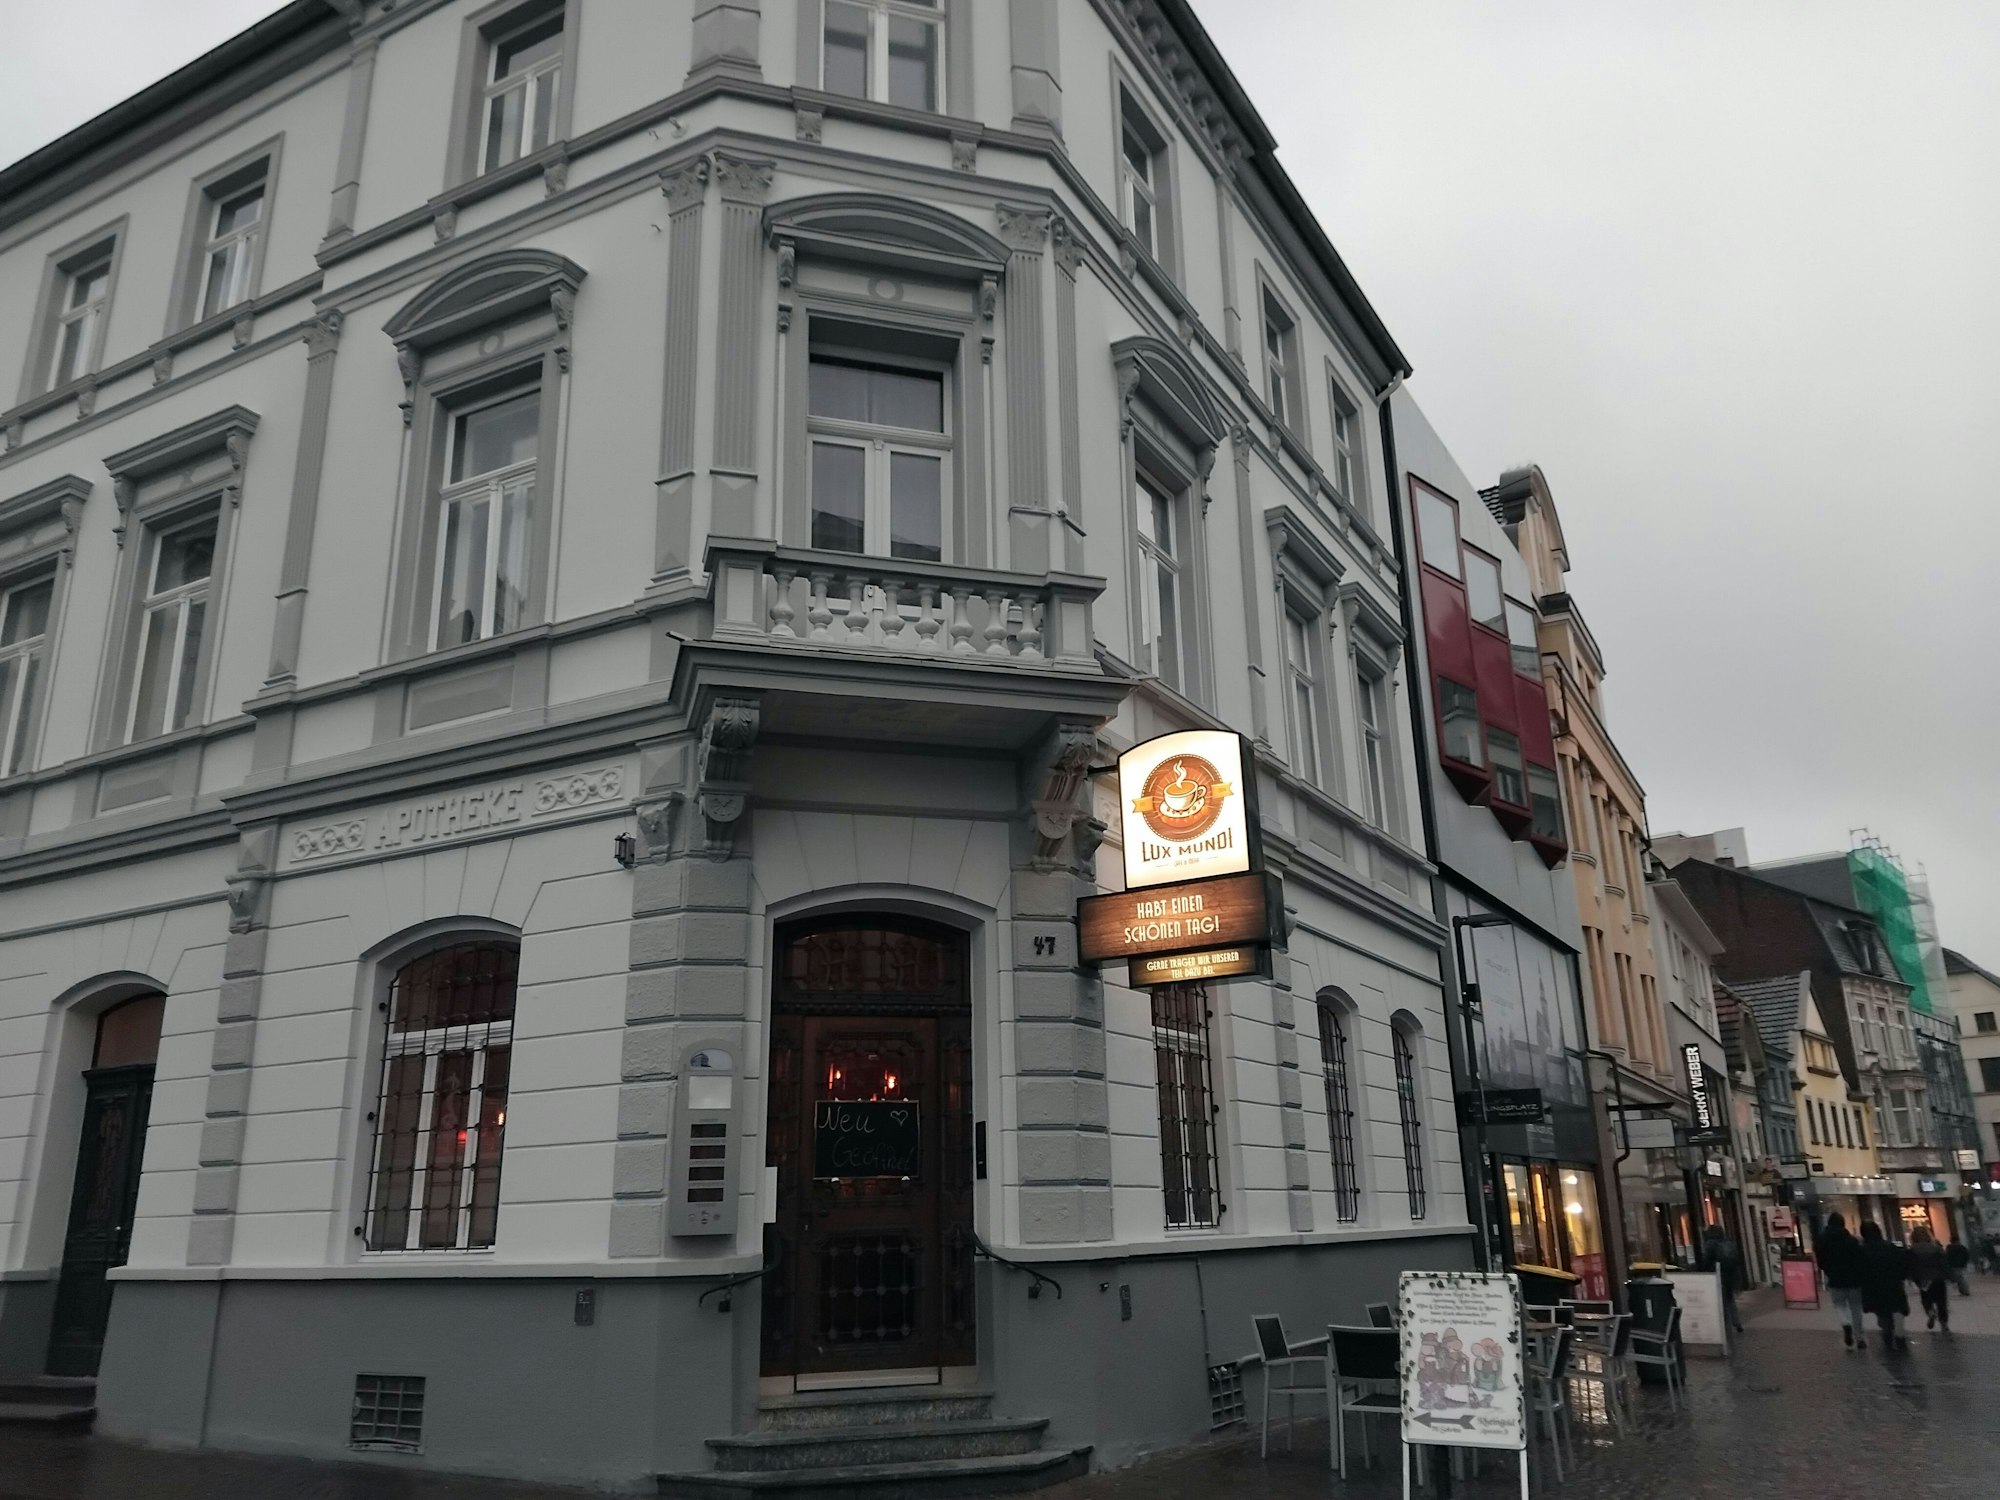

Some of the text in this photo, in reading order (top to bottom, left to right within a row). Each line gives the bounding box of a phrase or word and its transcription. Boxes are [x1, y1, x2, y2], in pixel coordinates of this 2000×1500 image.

[374, 783, 523, 849] APOTHEKE
[1142, 827, 1233, 862] LUX MUNDI
[1136, 894, 1203, 919] HABT EINEN
[1124, 915, 1220, 944] SCHÖNEN TAG!
[1146, 951, 1240, 971] GERNE TRAGEN WIR UNSEREN
[1171, 969, 1183, 979] TEIL
[1184, 967, 1202, 977] DAZU
[1685, 1046, 1704, 1089] WEBER
[818, 1105, 876, 1134] Neu
[1692, 1090, 1710, 1128] GERRY
